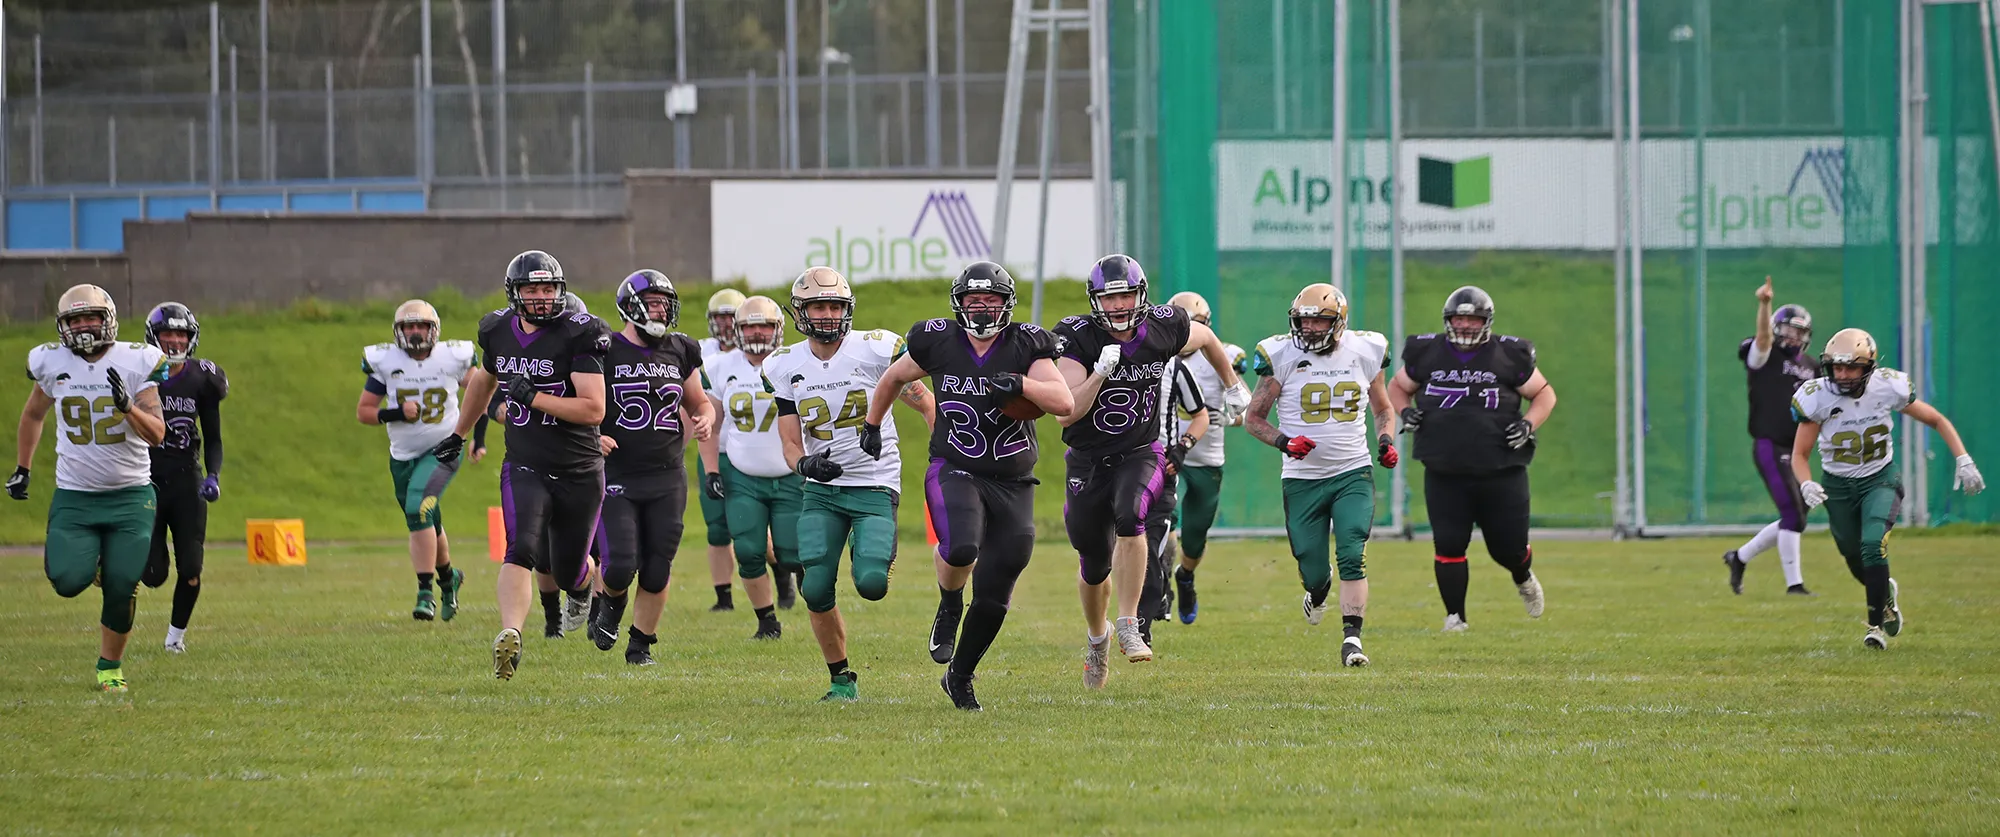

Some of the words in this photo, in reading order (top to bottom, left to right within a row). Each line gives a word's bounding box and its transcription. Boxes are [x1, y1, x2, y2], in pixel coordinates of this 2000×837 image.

[1254, 167, 1404, 213] Alpne
[1677, 184, 1826, 240] alpine
[805, 226, 948, 278] alpine
[496, 356, 555, 377] RAMS
[614, 362, 682, 380] RAMS
[1430, 370, 1497, 384] RAMS
[396, 387, 448, 424] 58
[611, 381, 684, 433] 52
[729, 391, 778, 433] 97
[798, 388, 868, 441] 24
[1093, 383, 1158, 435] 81
[1300, 382, 1361, 424] 93
[1425, 384, 1500, 410] 71
[61, 396, 127, 445] 92
[939, 400, 1030, 461] 32
[1831, 424, 1889, 465] 26
